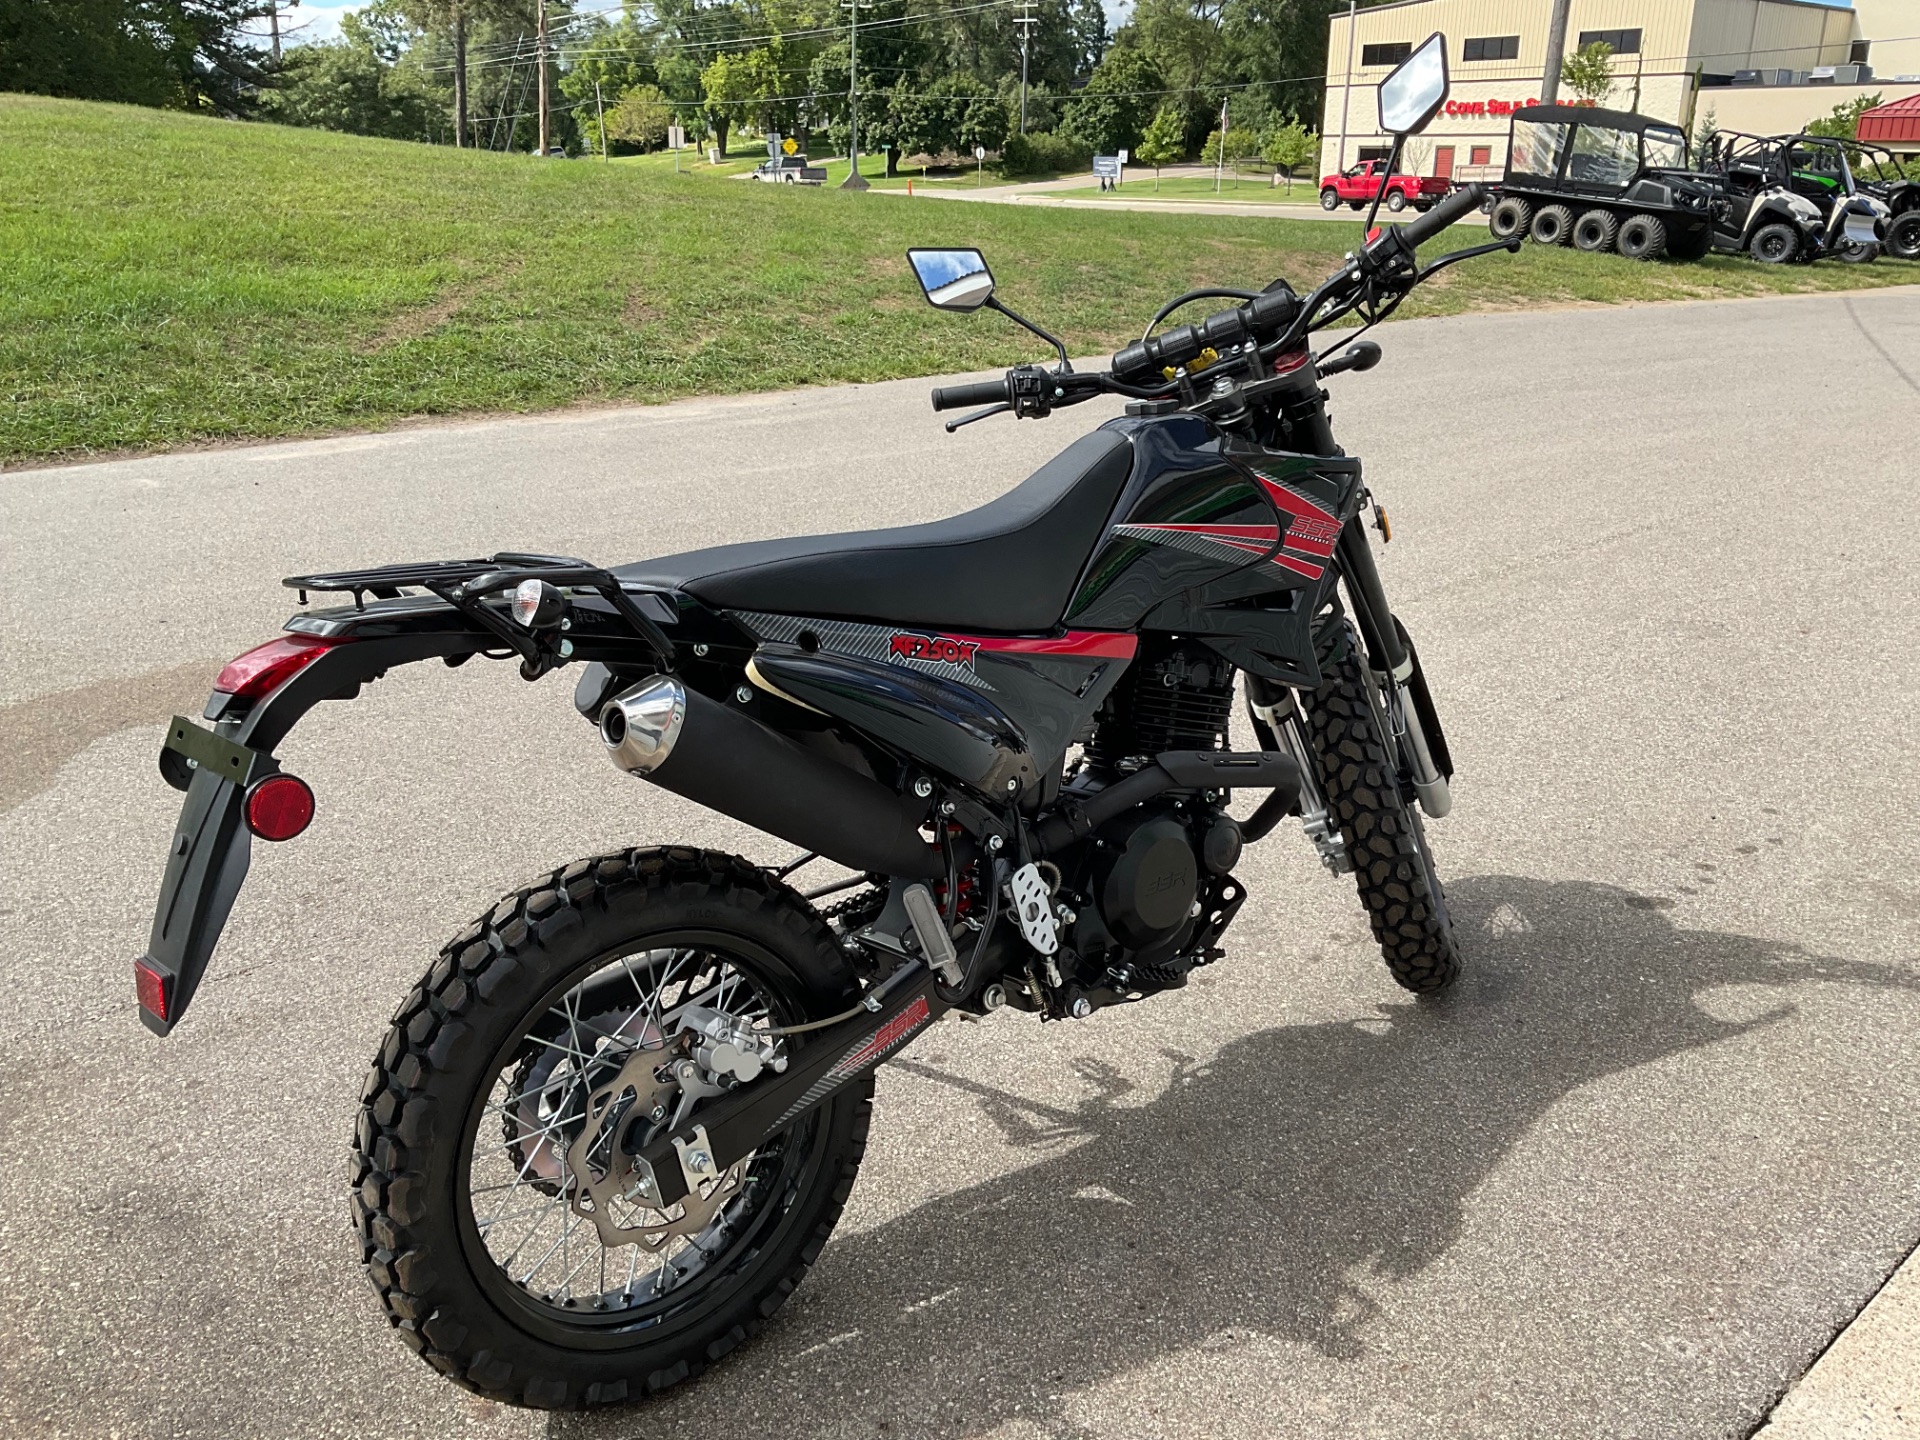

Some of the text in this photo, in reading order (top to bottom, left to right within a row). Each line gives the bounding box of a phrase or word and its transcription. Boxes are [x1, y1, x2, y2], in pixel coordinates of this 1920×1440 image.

[1445, 100, 1484, 115] COVE
[1289, 514, 1340, 545] SSR
[889, 632, 978, 669] XF250X
[873, 999, 925, 1054] SSR
